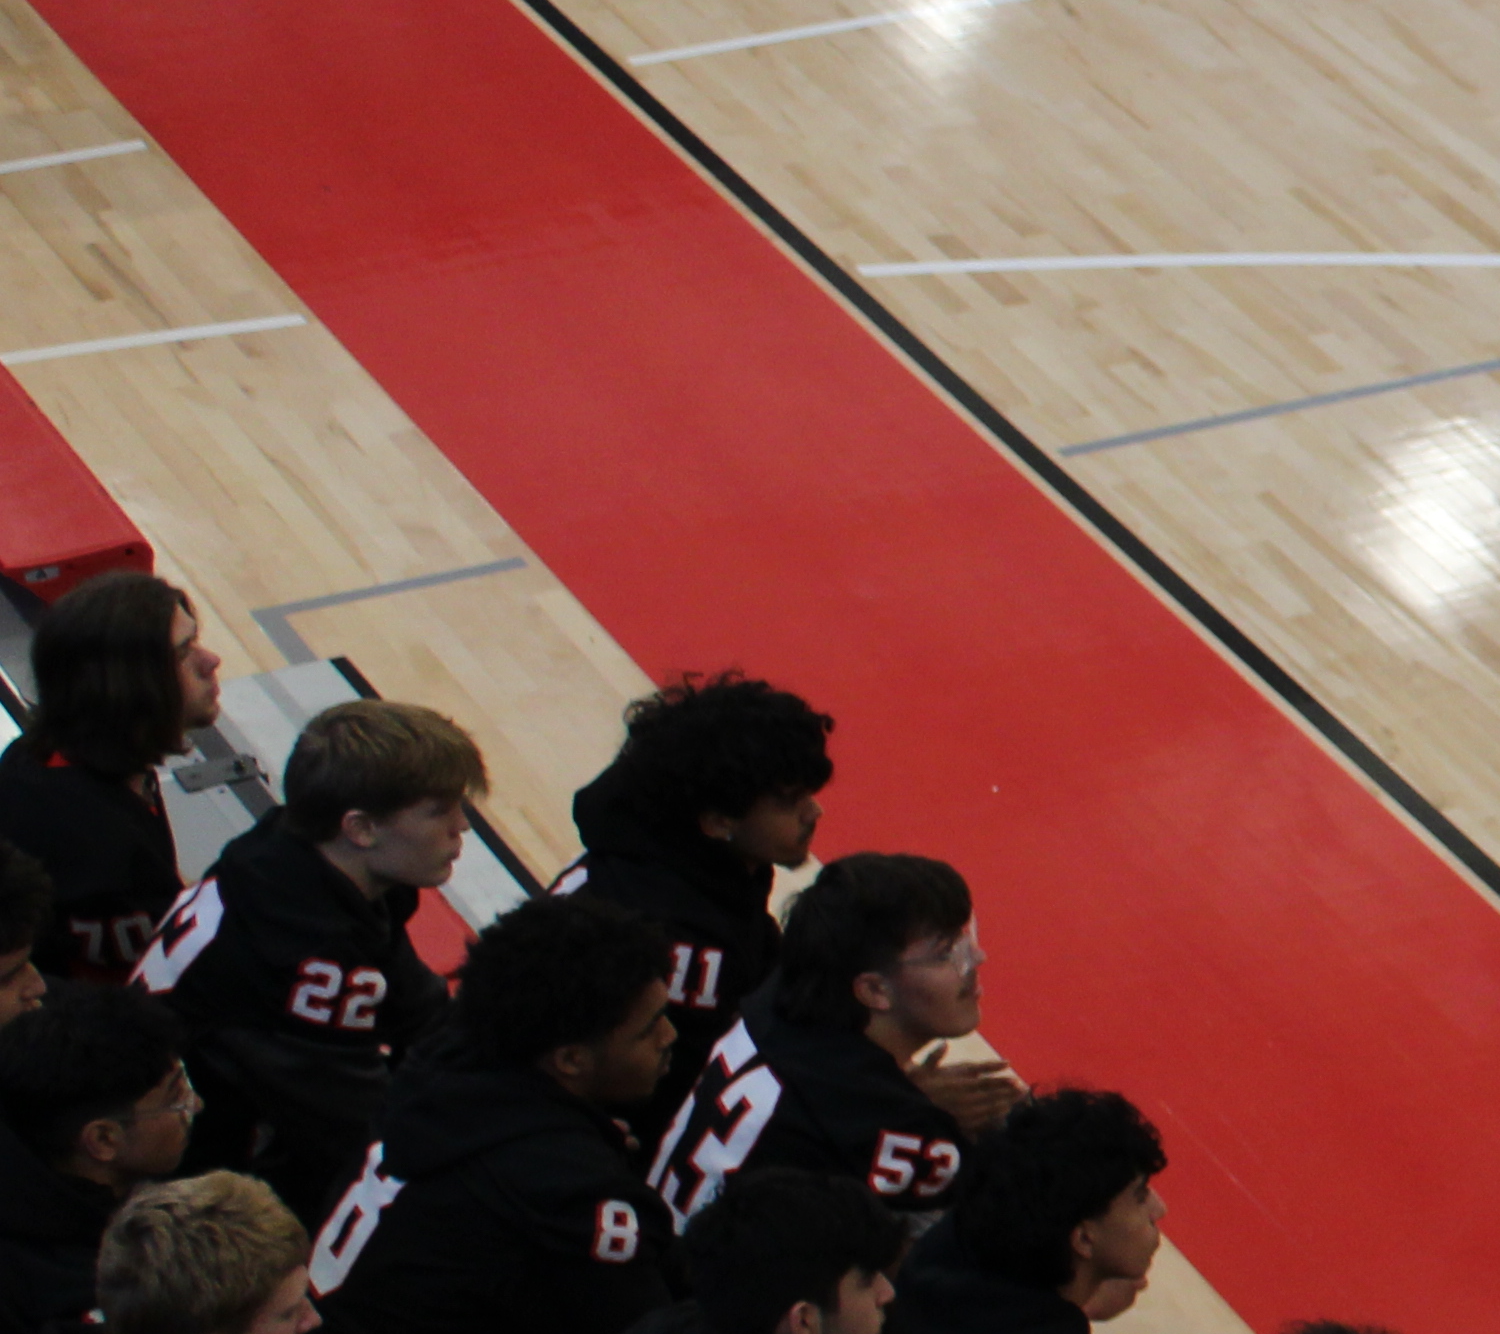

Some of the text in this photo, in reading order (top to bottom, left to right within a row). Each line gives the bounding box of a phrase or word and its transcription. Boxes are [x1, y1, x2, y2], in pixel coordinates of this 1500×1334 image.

[287, 957, 388, 1031] 22
[666, 941, 725, 1011] 11
[869, 1129, 962, 1200] 53
[591, 1199, 640, 1264] 8
